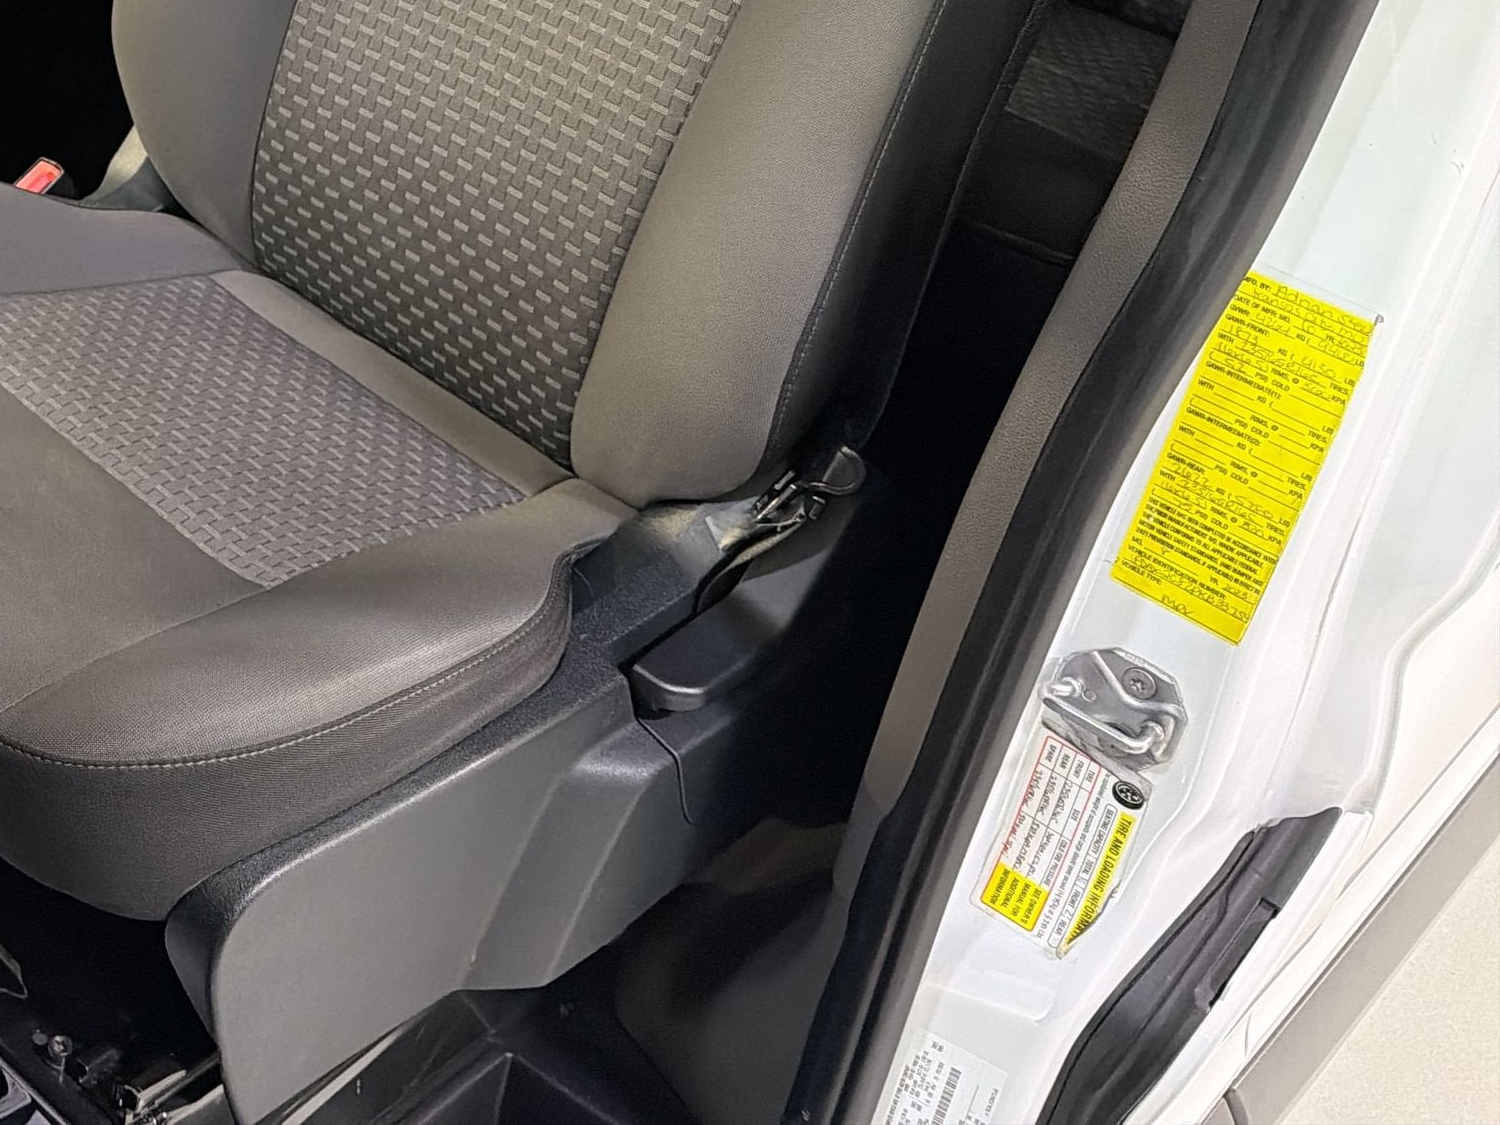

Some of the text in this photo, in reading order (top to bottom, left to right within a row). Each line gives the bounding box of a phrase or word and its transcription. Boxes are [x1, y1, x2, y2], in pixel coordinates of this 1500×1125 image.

[1223, 312, 1271, 338] GAWR-FRONT:
[1155, 527, 1173, 540] VEHICLE
[1158, 501, 1177, 515] VEHICLE
[1230, 538, 1262, 559] ACCORDANCE
[1120, 559, 1163, 586] VEHICLE TYPE:
[1127, 543, 1153, 562] VEHICLE
[1152, 556, 1198, 586] IDENTIFICATION
[1197, 580, 1228, 601] NUMBER:
[1043, 743, 1058, 763] SPARE
[1071, 759, 1085, 778] FRONT
[1098, 808, 1115, 831] SEATING
[1088, 828, 1107, 855] CAPACITY
[1081, 858, 1094, 876] TOTAL
[1091, 854, 1118, 894] LOADING
[988, 867, 1011, 905] INFORMATION
[1000, 876, 1020, 909] ADDITIONAL
[1015, 881, 1031, 906] MANUAL
[1067, 888, 1081, 908] FRONT
